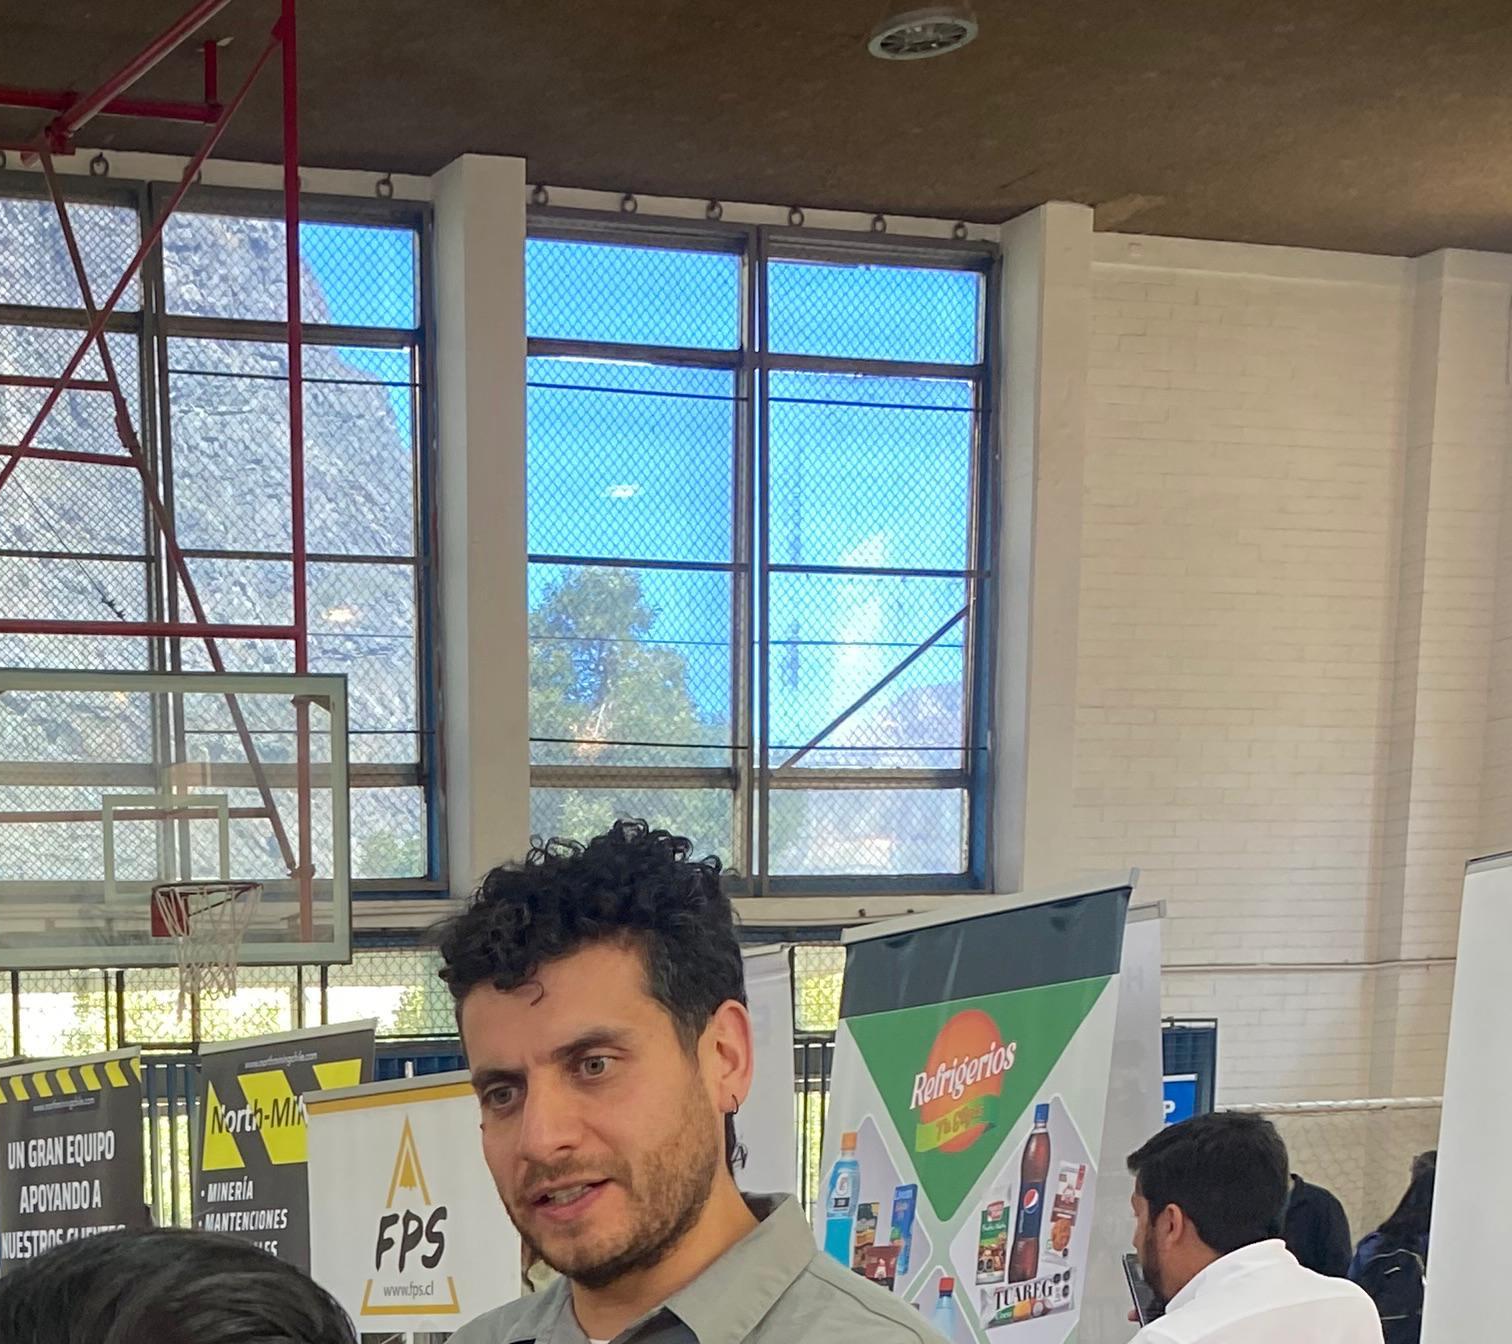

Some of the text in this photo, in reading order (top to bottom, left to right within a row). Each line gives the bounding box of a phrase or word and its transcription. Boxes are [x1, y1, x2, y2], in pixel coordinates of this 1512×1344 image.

[8, 1130, 115, 1170] UN GRAN EQUIPO
[19, 1179, 102, 1214] APOYANDO A
[207, 1175, 254, 1202] MINERÍA
[204, 1208, 288, 1232] MANTENCIONES
[375, 1206, 448, 1274] FPS
[383, 1280, 434, 1300] www.fps.cl
[994, 1279, 1052, 1310] TUAREG
